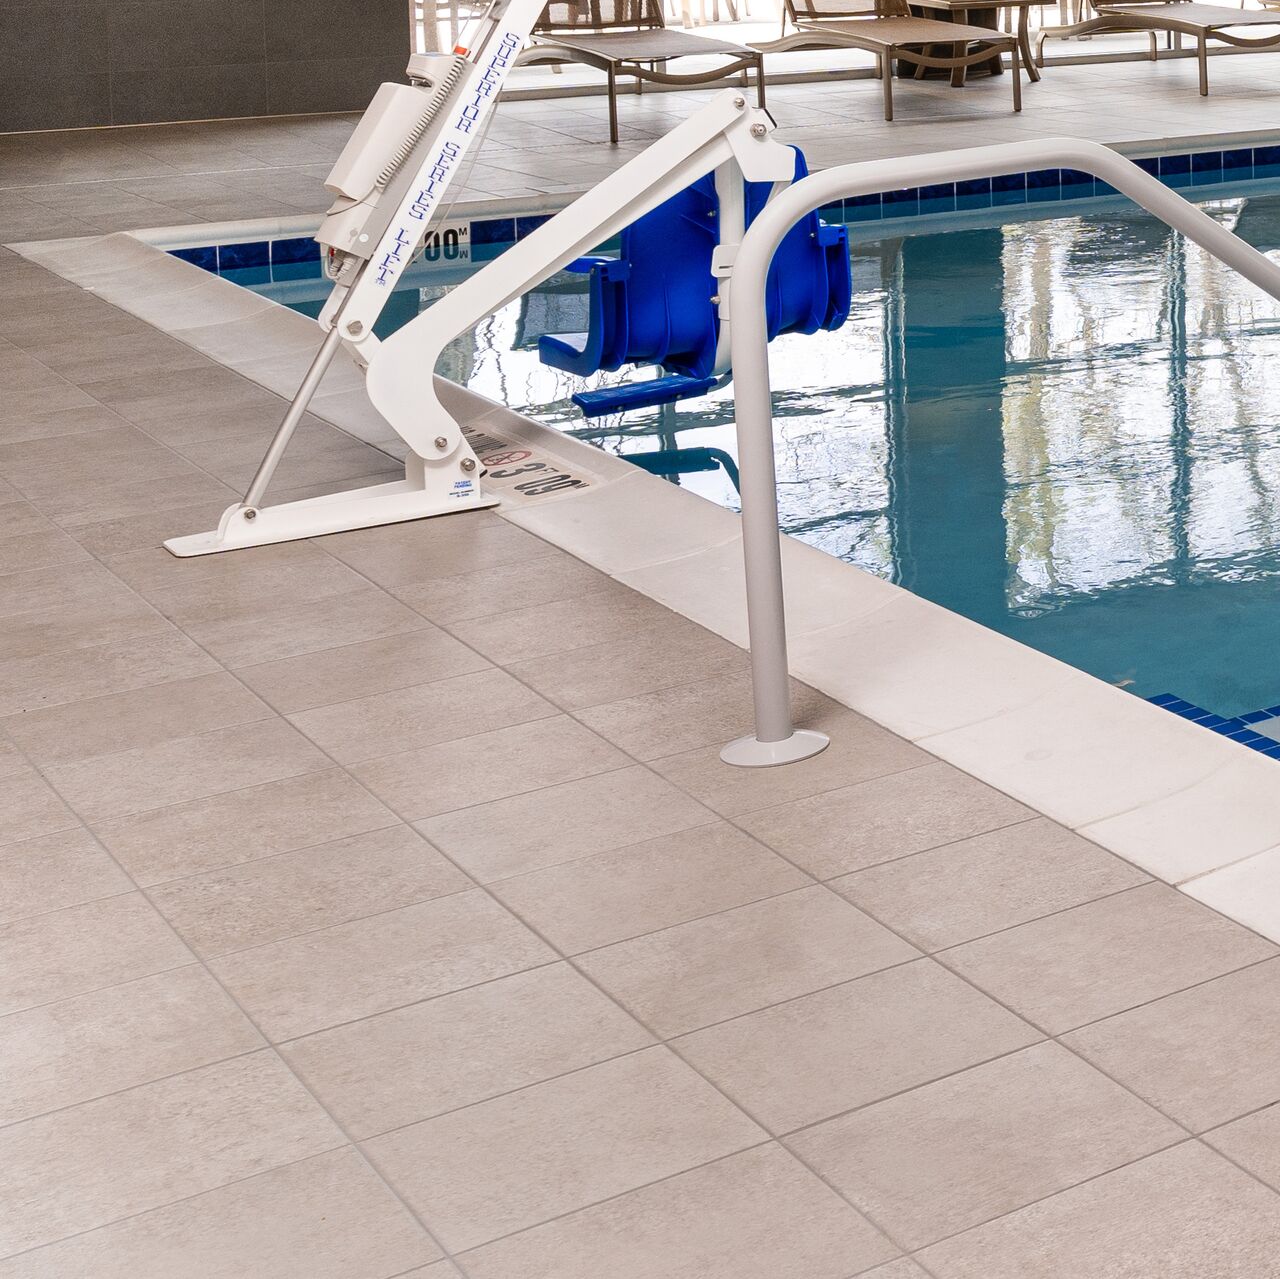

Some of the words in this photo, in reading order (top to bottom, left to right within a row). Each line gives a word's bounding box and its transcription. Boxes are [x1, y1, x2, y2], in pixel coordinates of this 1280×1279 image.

[454, 32, 520, 133] SUPERIOR
[408, 141, 461, 220] SERIES
[377, 227, 410, 282] LIFT
[489, 462, 547, 479] 3
